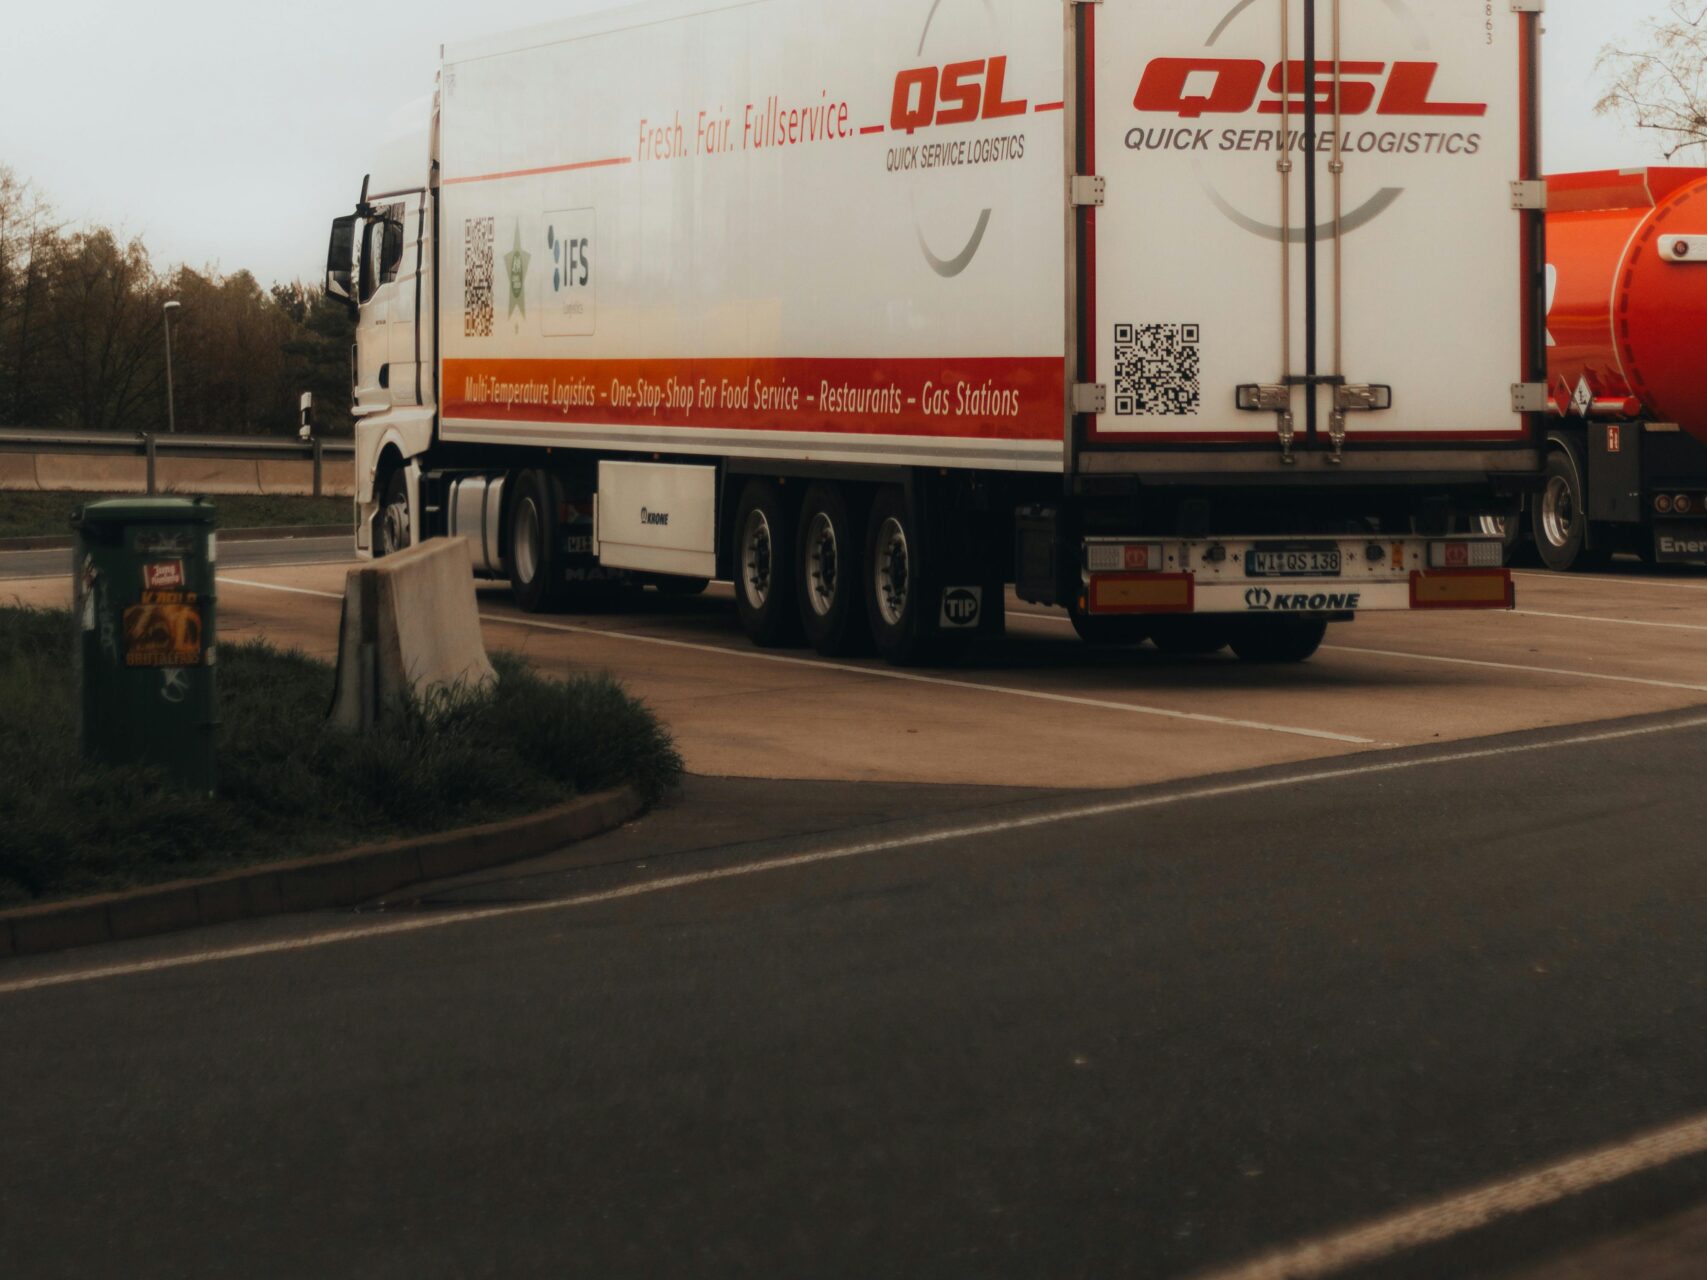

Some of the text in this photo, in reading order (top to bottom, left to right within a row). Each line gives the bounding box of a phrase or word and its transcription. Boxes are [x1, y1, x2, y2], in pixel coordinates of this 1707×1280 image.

[889, 55, 1028, 135] QSL
[1132, 57, 1488, 118] QSL
[638, 89, 853, 162] Fresh. Fair. Fullservice.
[1123, 127, 1213, 150] QUICK
[1340, 131, 1482, 154] LOGISTICS
[886, 133, 1025, 172] QUICK SERVICE LOGISTICS
[563, 237, 589, 287] IFS
[464, 374, 549, 412] Multi-Temperature
[551, 376, 596, 414] Logistics
[611, 376, 694, 417] One-Stop-Shop
[698, 378, 717, 409] For
[720, 376, 750, 410] Food
[753, 376, 799, 410] Service
[819, 379, 902, 415] Restaurants
[921, 380, 950, 416] Gas
[955, 378, 1020, 417] Stations
[1286, 553, 1307, 570] QS
[1310, 553, 1338, 570] 138
[1659, 536, 1707, 553] Ener
[946, 599, 976, 617] TIP
[1273, 593, 1361, 609] KRONE
